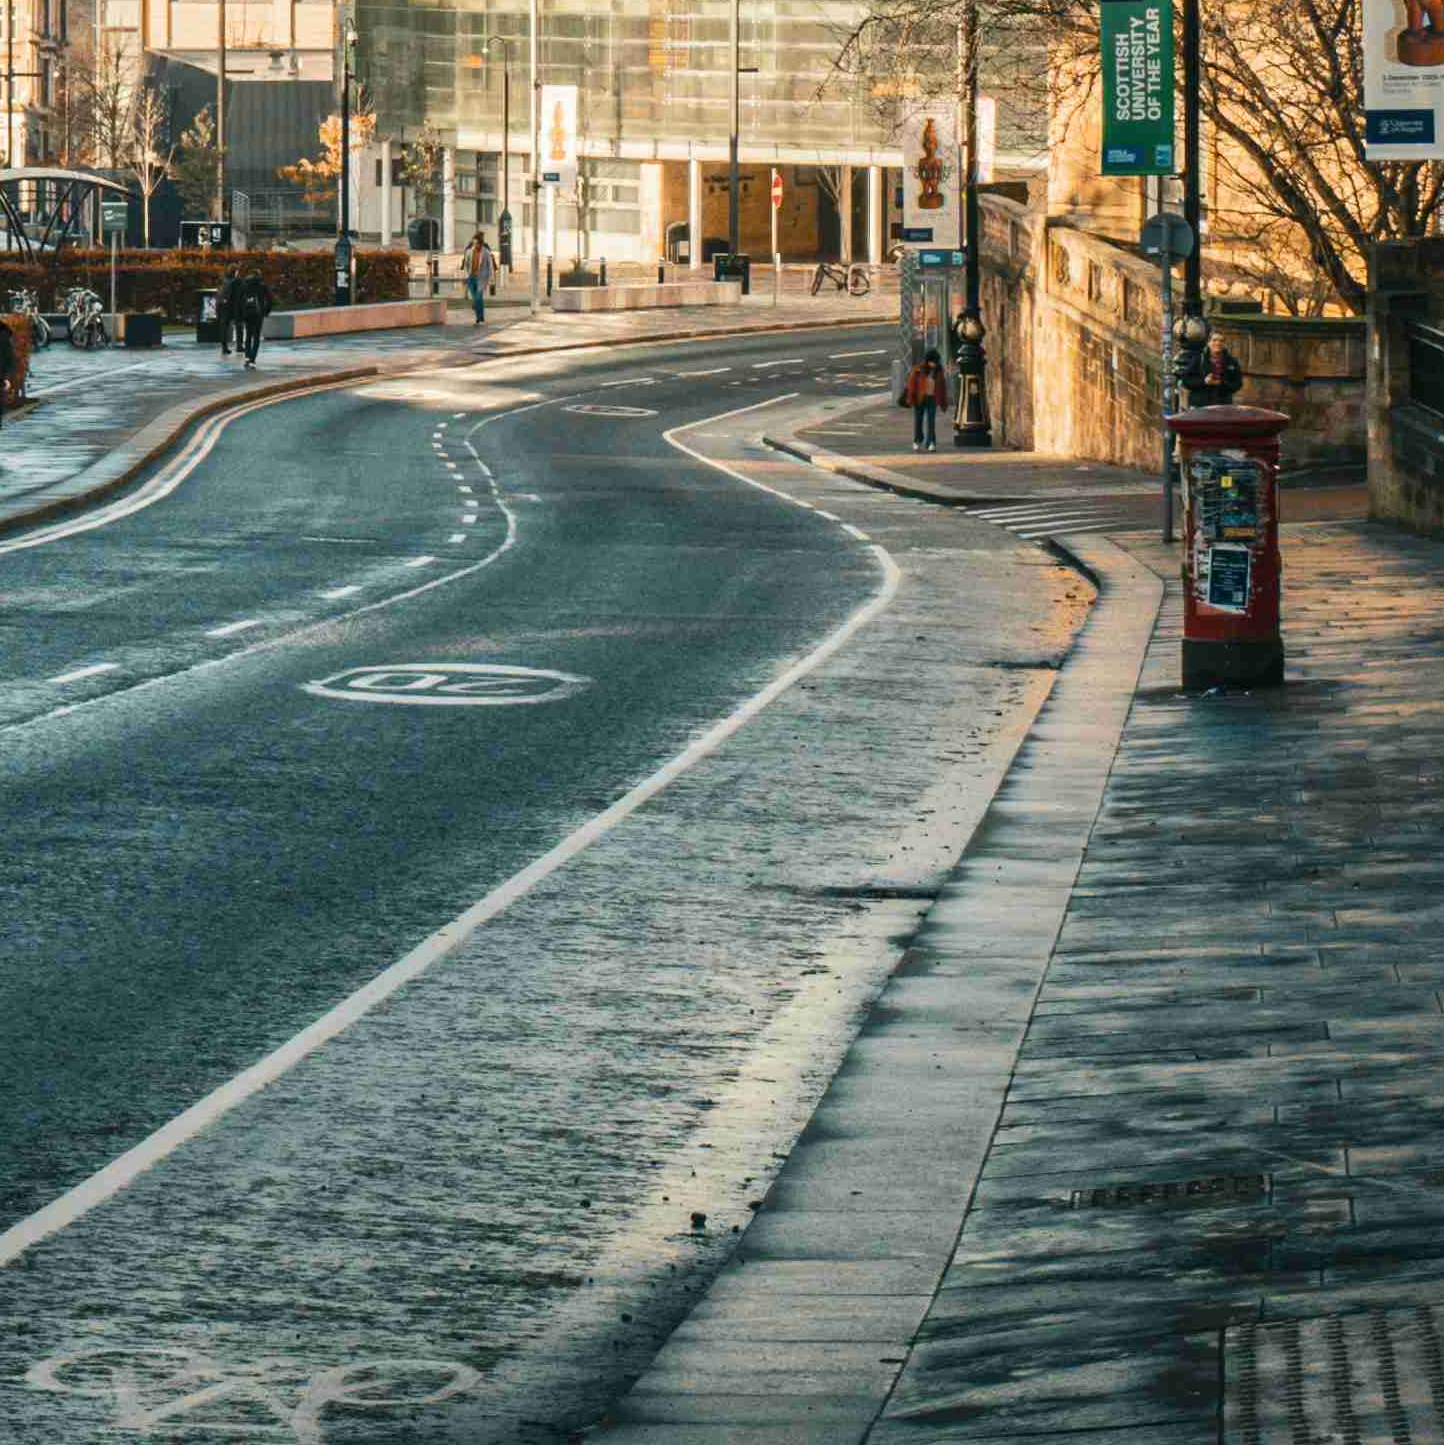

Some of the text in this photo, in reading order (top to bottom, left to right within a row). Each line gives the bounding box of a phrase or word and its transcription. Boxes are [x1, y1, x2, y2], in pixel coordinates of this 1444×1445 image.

[1115, 33, 1131, 121] SCOTTISH
[1129, 16, 1146, 121] UNIVERSITY
[1145, 7, 1161, 121] OF THE YEAR
